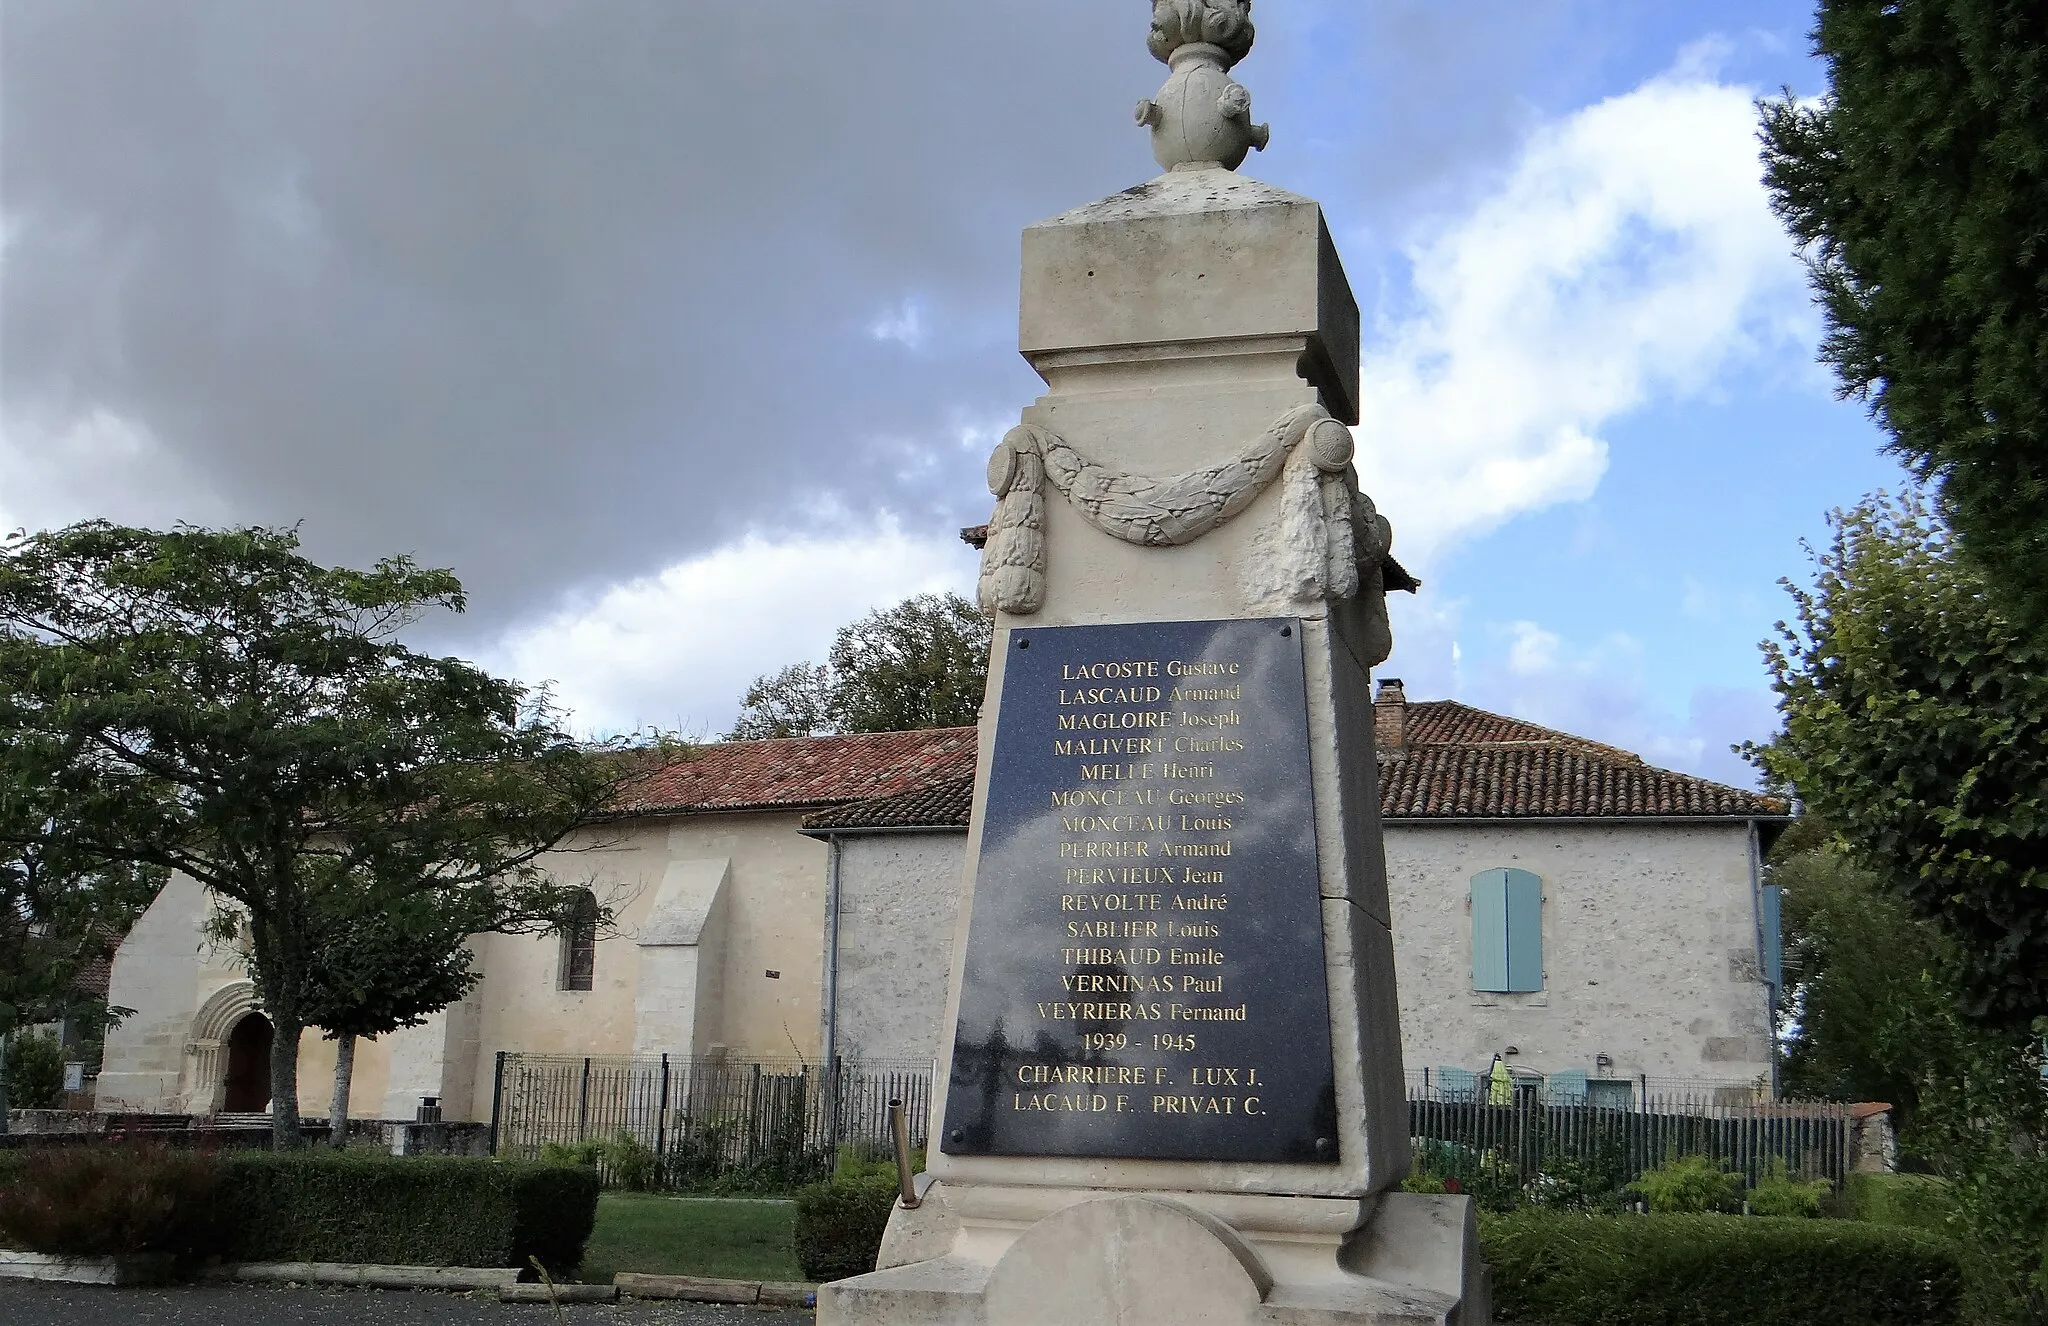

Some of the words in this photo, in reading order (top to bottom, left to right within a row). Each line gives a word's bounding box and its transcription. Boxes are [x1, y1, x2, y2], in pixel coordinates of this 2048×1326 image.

[1063, 661, 1159, 680] LACOSTE
[1167, 660, 1239, 677] Gustave
[1059, 687, 1161, 705] LASCAUD
[1169, 685, 1241, 702] Armand
[1058, 711, 1172, 730] MAGLOIRE
[1179, 710, 1240, 729] Joseph
[1055, 738, 1166, 756] MALIVERT
[1175, 736, 1243, 753] Charles
[1081, 764, 1153, 781] MELLE
[1163, 761, 1213, 779] Henri
[1051, 790, 1159, 807] MONCEAU
[1169, 789, 1244, 807] Georges
[1062, 816, 1171, 832] MONCEAU
[1181, 814, 1232, 831] Louis
[1060, 841, 1149, 858] PERRIER
[1159, 841, 1231, 856] Armand
[1066, 867, 1174, 884] PERVIEUX
[1182, 868, 1223, 883] Jean
[1061, 894, 1161, 911] REVOLTE
[1171, 893, 1227, 911] André
[1067, 922, 1157, 938] SABLIER
[1168, 921, 1219, 938] Louis
[1061, 948, 1161, 965] THIBAUD
[1170, 948, 1224, 965] Emile
[1062, 975, 1173, 992] VERNINAS
[1182, 975, 1223, 992] Paul
[1037, 1003, 1161, 1020] VEYRIERAS
[1170, 1004, 1246, 1021] Fernand
[1083, 1034, 1127, 1050] 1939
[1153, 1034, 1195, 1051] 1945
[1018, 1066, 1145, 1084] CHARRIERE
[1155, 1067, 1173, 1084] F.
[1192, 1068, 1239, 1085] LUX
[1246, 1069, 1263, 1086] J.
[1014, 1093, 1107, 1111] LACAUD
[1116, 1095, 1134, 1112] F.
[1153, 1096, 1235, 1114] PRIVAT
[1244, 1097, 1267, 1115] C.
